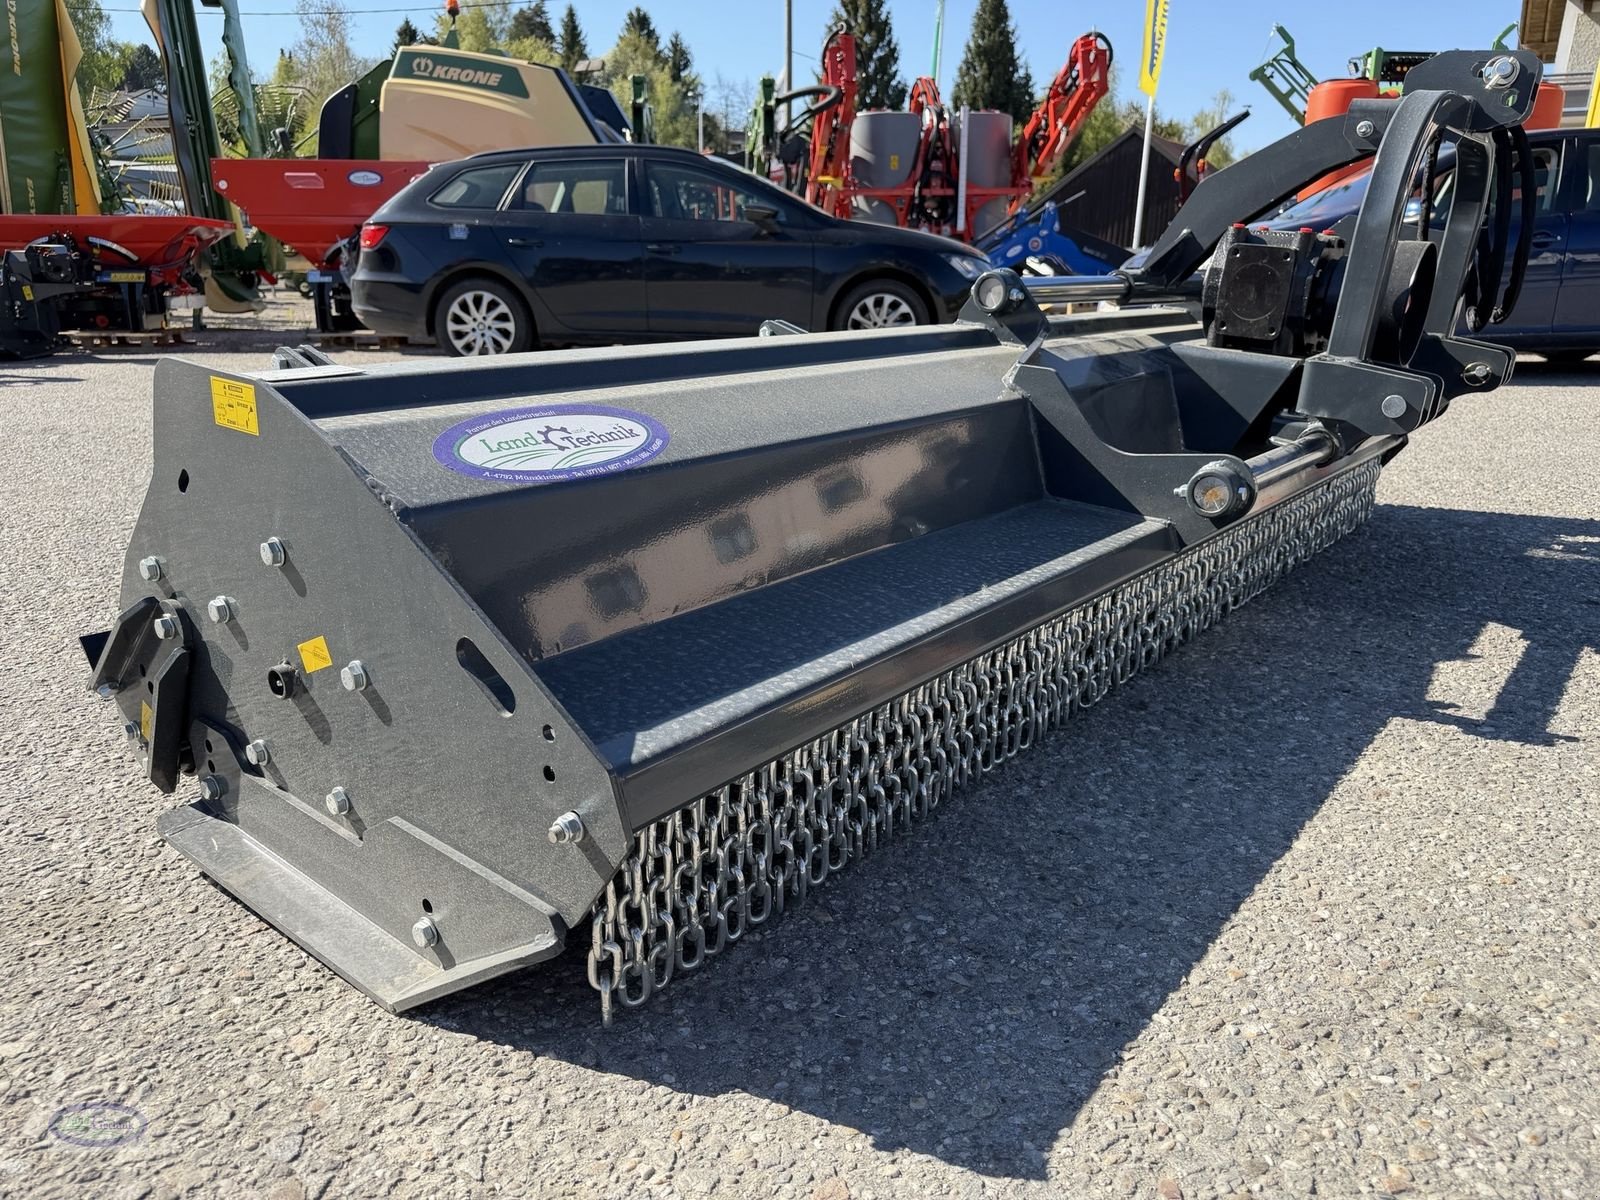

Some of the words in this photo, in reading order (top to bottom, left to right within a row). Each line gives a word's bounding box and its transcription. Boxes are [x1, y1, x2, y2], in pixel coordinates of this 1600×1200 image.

[8, 11, 21, 77] KRONE
[432, 65, 503, 86] KRONE
[479, 432, 543, 454] Land
[561, 424, 641, 449] Technik
